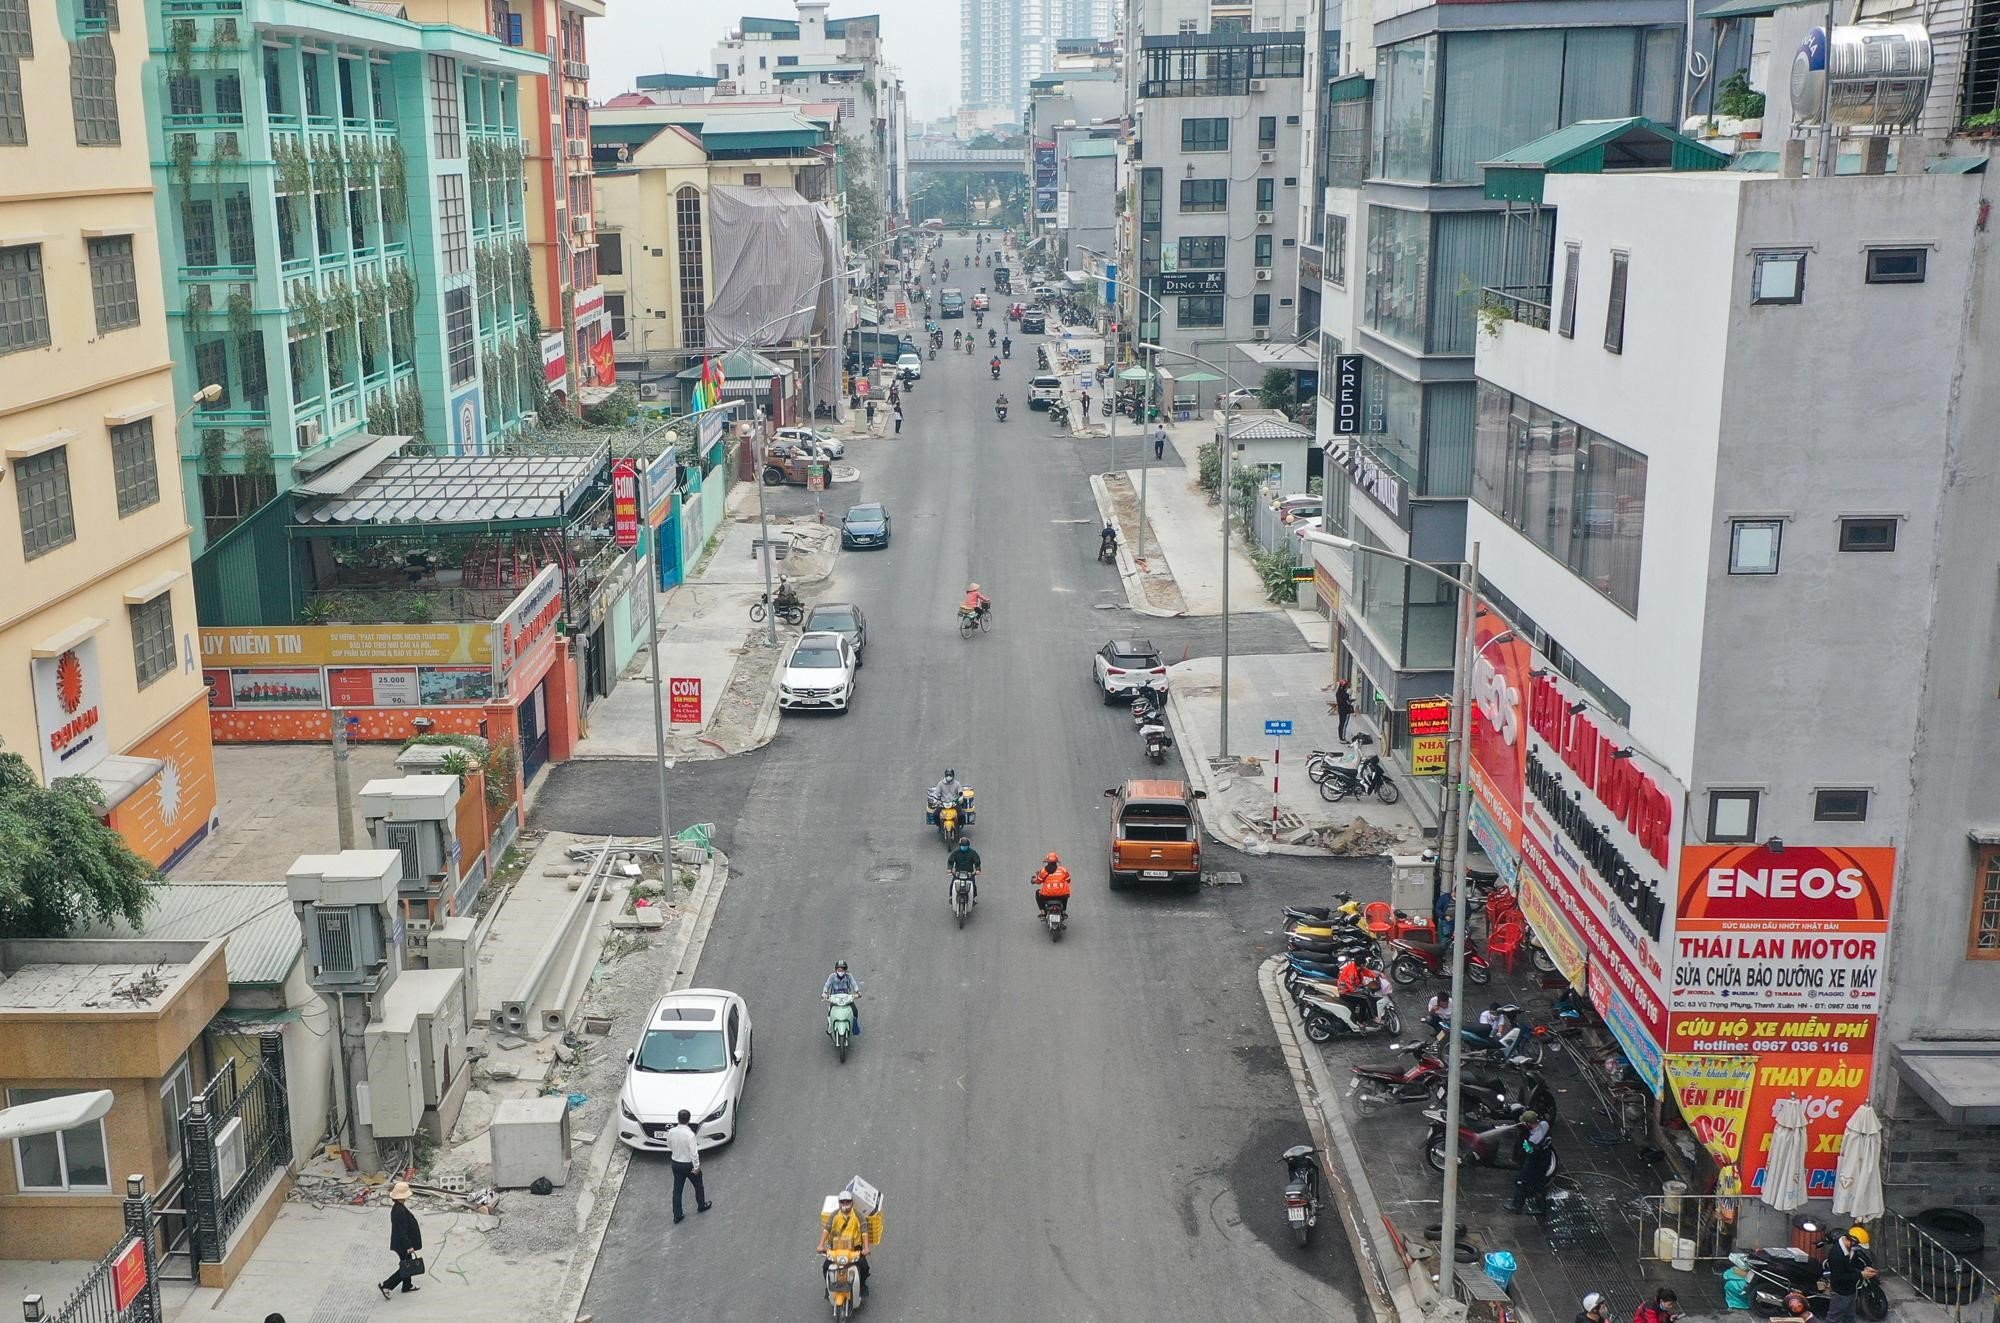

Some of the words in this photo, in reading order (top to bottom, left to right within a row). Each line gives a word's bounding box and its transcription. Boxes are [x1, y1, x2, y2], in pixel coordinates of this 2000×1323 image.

[1166, 281, 1195, 290] DING
[1198, 281, 1219, 289] TEA
[1340, 359, 1355, 431] KREDO
[615, 475, 634, 498] CƠM
[184, 632, 195, 676] A
[200, 631, 224, 655] ŨY
[274, 634, 303, 654] TIN
[378, 676, 405, 684] 25.000
[672, 680, 699, 695] CƠM
[1707, 867, 1863, 899] ENEOS
[1722, 921, 1738, 929] SỨC
[1679, 935, 1733, 959] THÁI
[1738, 939, 1785, 959] LAN
[1791, 939, 1876, 960] MOTOR
[1675, 961, 1701, 987] SỬA
[1706, 963, 1741, 987] CHỮA
[1746, 962, 1773, 987] BẢO
[1776, 963, 1823, 988] DƯỠNG
[1828, 968, 1846, 988] XE
[1850, 964, 1877, 988] MÁY
[1709, 1001, 1729, 1010] Trọng
[1777, 1001, 1795, 1009] Xuân
[1676, 1017, 1716, 1036] CỨU
[1718, 1018, 1749, 1041] HỘ
[1751, 1021, 1777, 1037] XE
[1780, 1015, 1830, 1037] MIỄN
[1833, 1017, 1868, 1038] PHÍ
[1693, 1040, 1748, 1051] Hotline:
[1752, 1041, 1787, 1051] 0967
[1791, 1041, 1818, 1051] 036
[1822, 1042, 1848, 1052] 116
[1760, 1067, 1814, 1087] THAY
[1816, 1058, 1864, 1088] DẦU
[1809, 1168, 1837, 1188] PH
